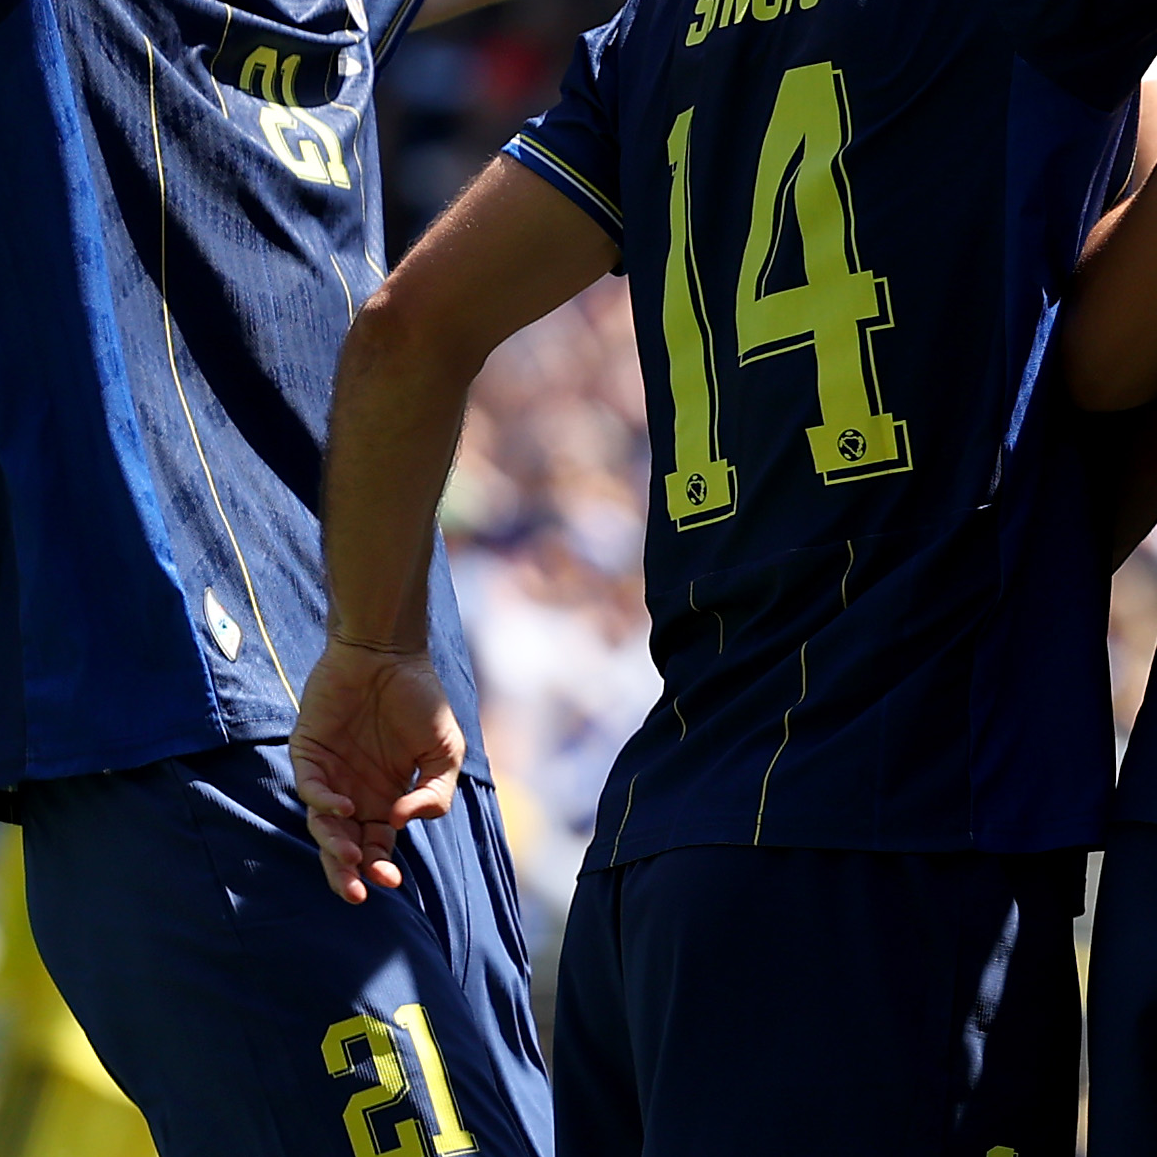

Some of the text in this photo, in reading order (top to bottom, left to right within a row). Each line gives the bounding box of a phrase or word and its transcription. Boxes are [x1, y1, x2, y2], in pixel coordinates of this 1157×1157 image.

[239, 45, 351, 190] 21
[662, 61, 914, 532] 14
[320, 1003, 480, 1157] 21
